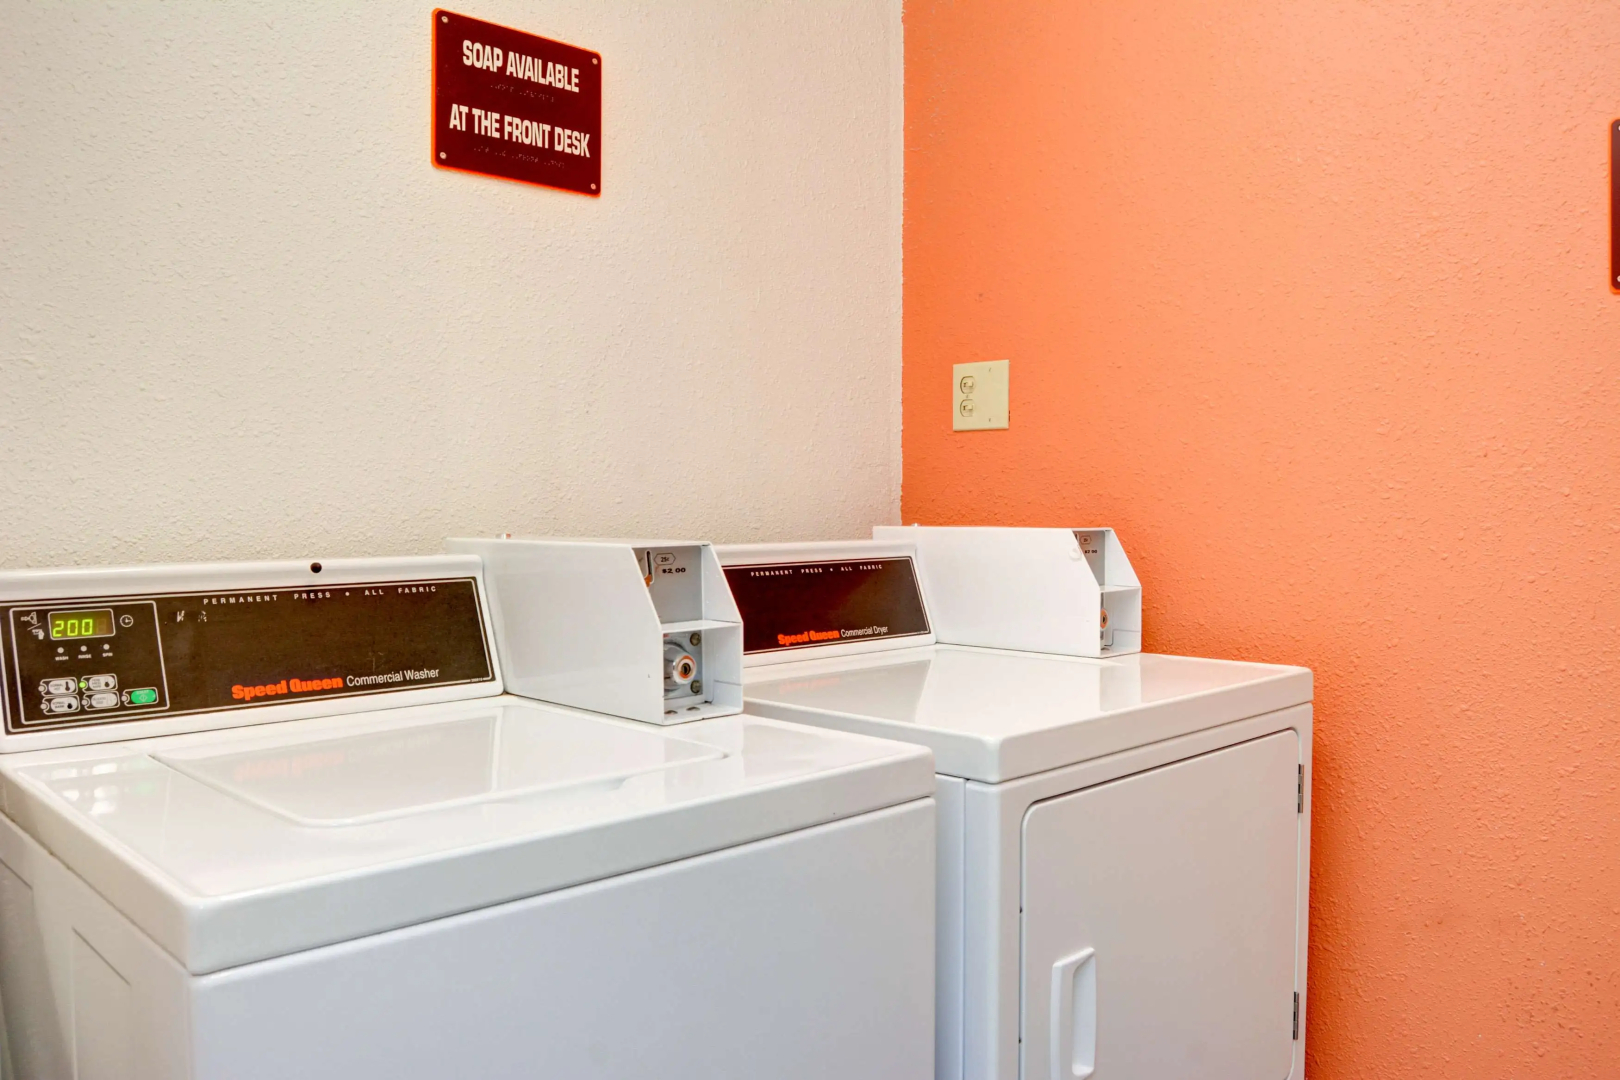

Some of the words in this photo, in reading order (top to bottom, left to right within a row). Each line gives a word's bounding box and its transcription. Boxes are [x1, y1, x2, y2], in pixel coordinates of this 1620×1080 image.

[462, 39, 503, 73] SOAP
[506, 51, 580, 93] AVAILABLE
[449, 103, 469, 132] AT
[471, 107, 501, 139] THE
[504, 114, 551, 149] FRONT
[554, 126, 590, 158] DESK
[750, 569, 793, 577] PERMANENT
[203, 594, 278, 605] PERMANENT
[293, 591, 331, 600] PRESS
[397, 585, 437, 594] FABRIC
[52, 619, 93, 637] 200
[777, 631, 810, 646] Speed
[809, 629, 840, 641] Queen
[840, 626, 873, 638] Commercial
[873, 625, 889, 635] Dryer
[231, 679, 288, 701] Speed
[289, 677, 344, 692] Queen
[346, 670, 403, 687] Commercial
[403, 668, 440, 681] Washer
